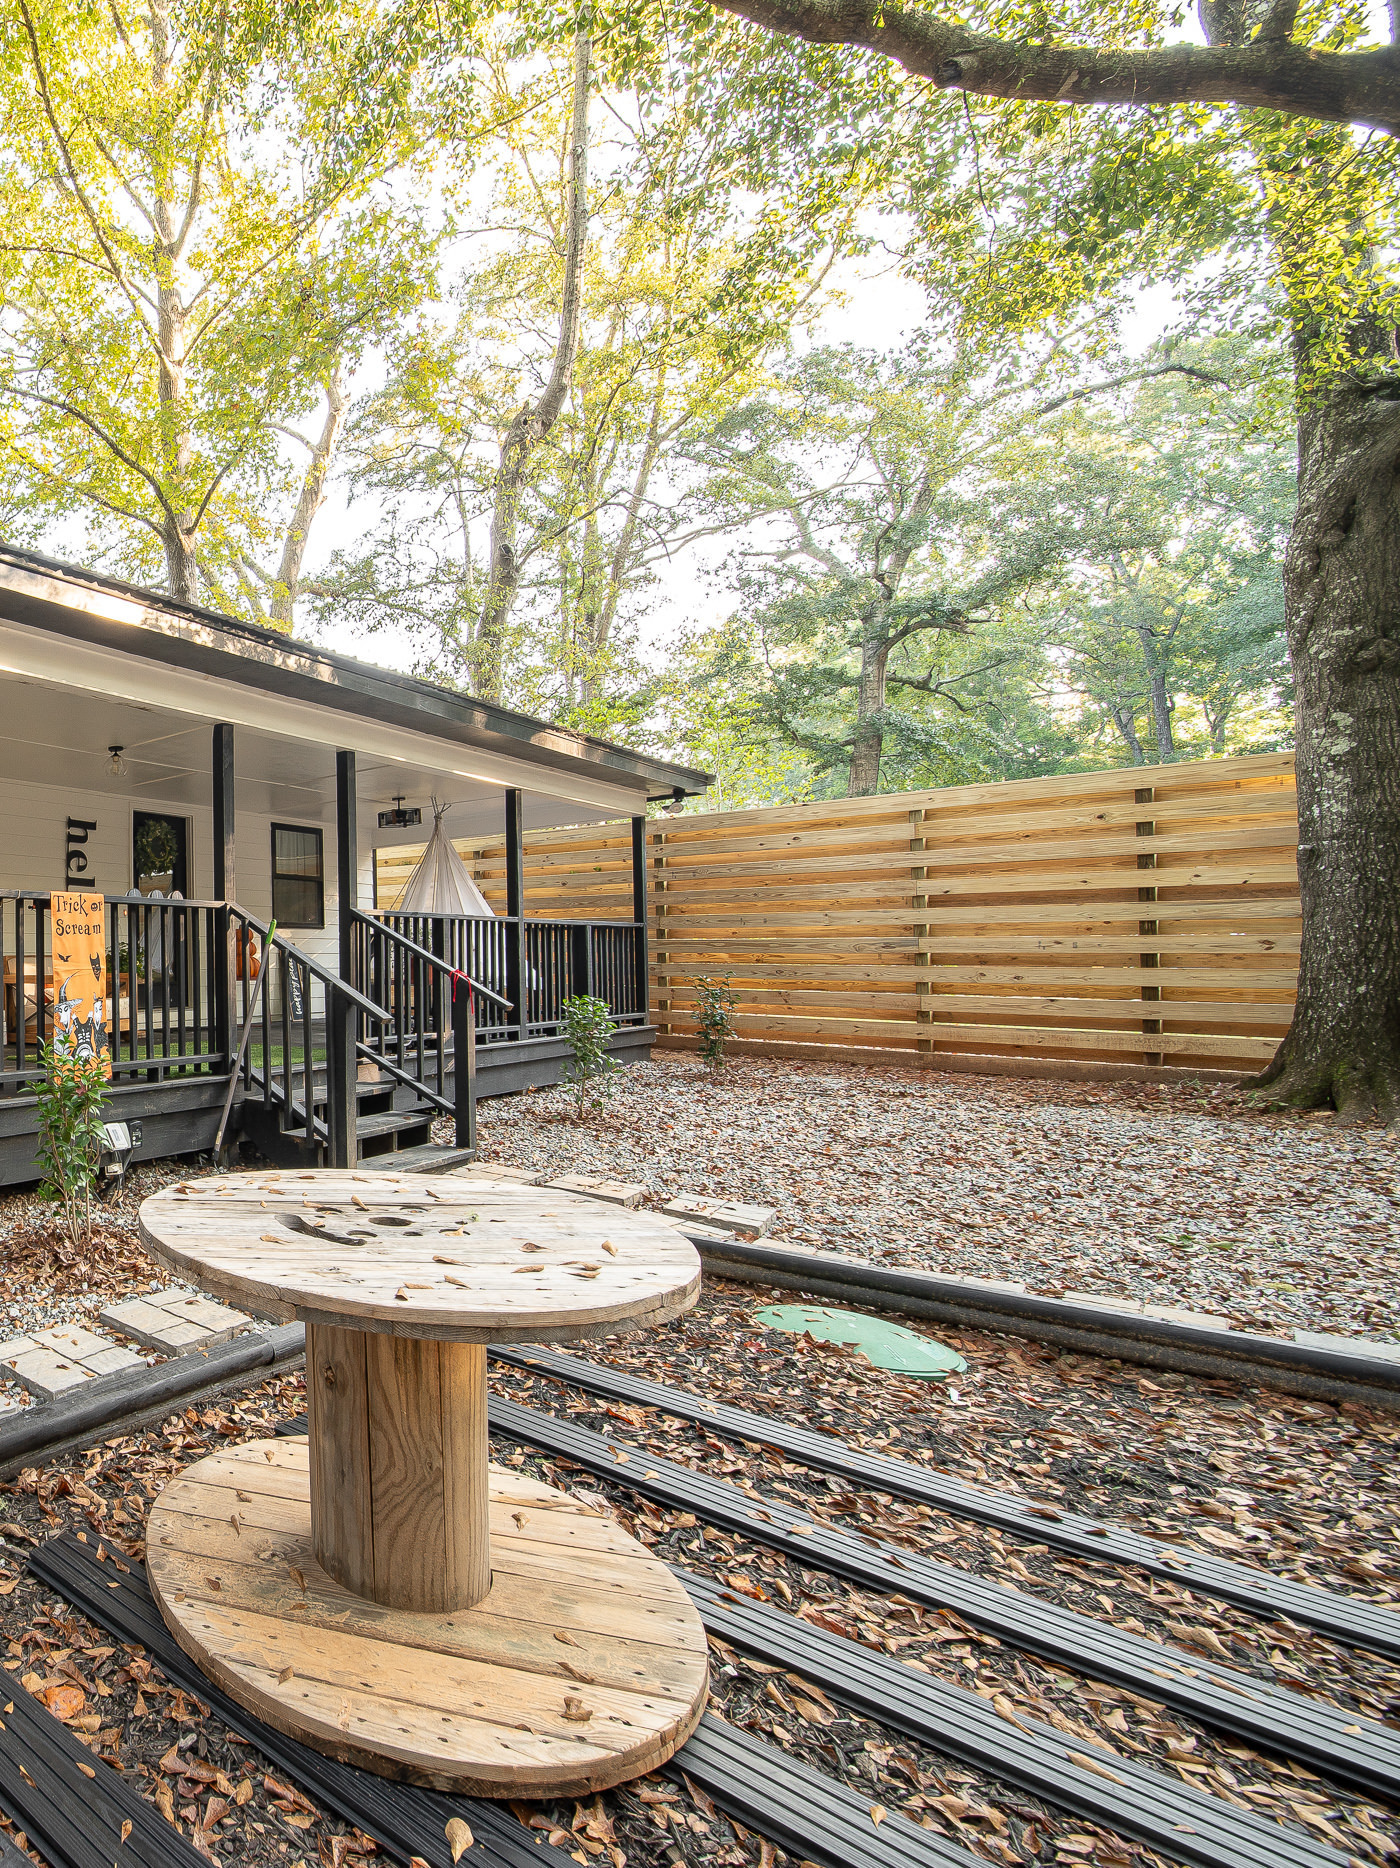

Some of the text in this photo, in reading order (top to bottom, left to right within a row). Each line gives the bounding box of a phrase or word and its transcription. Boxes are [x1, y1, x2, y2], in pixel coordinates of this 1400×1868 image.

[66, 816, 97, 892] hel
[53, 894, 103, 917] Trick or
[55, 919, 102, 937] Scream
